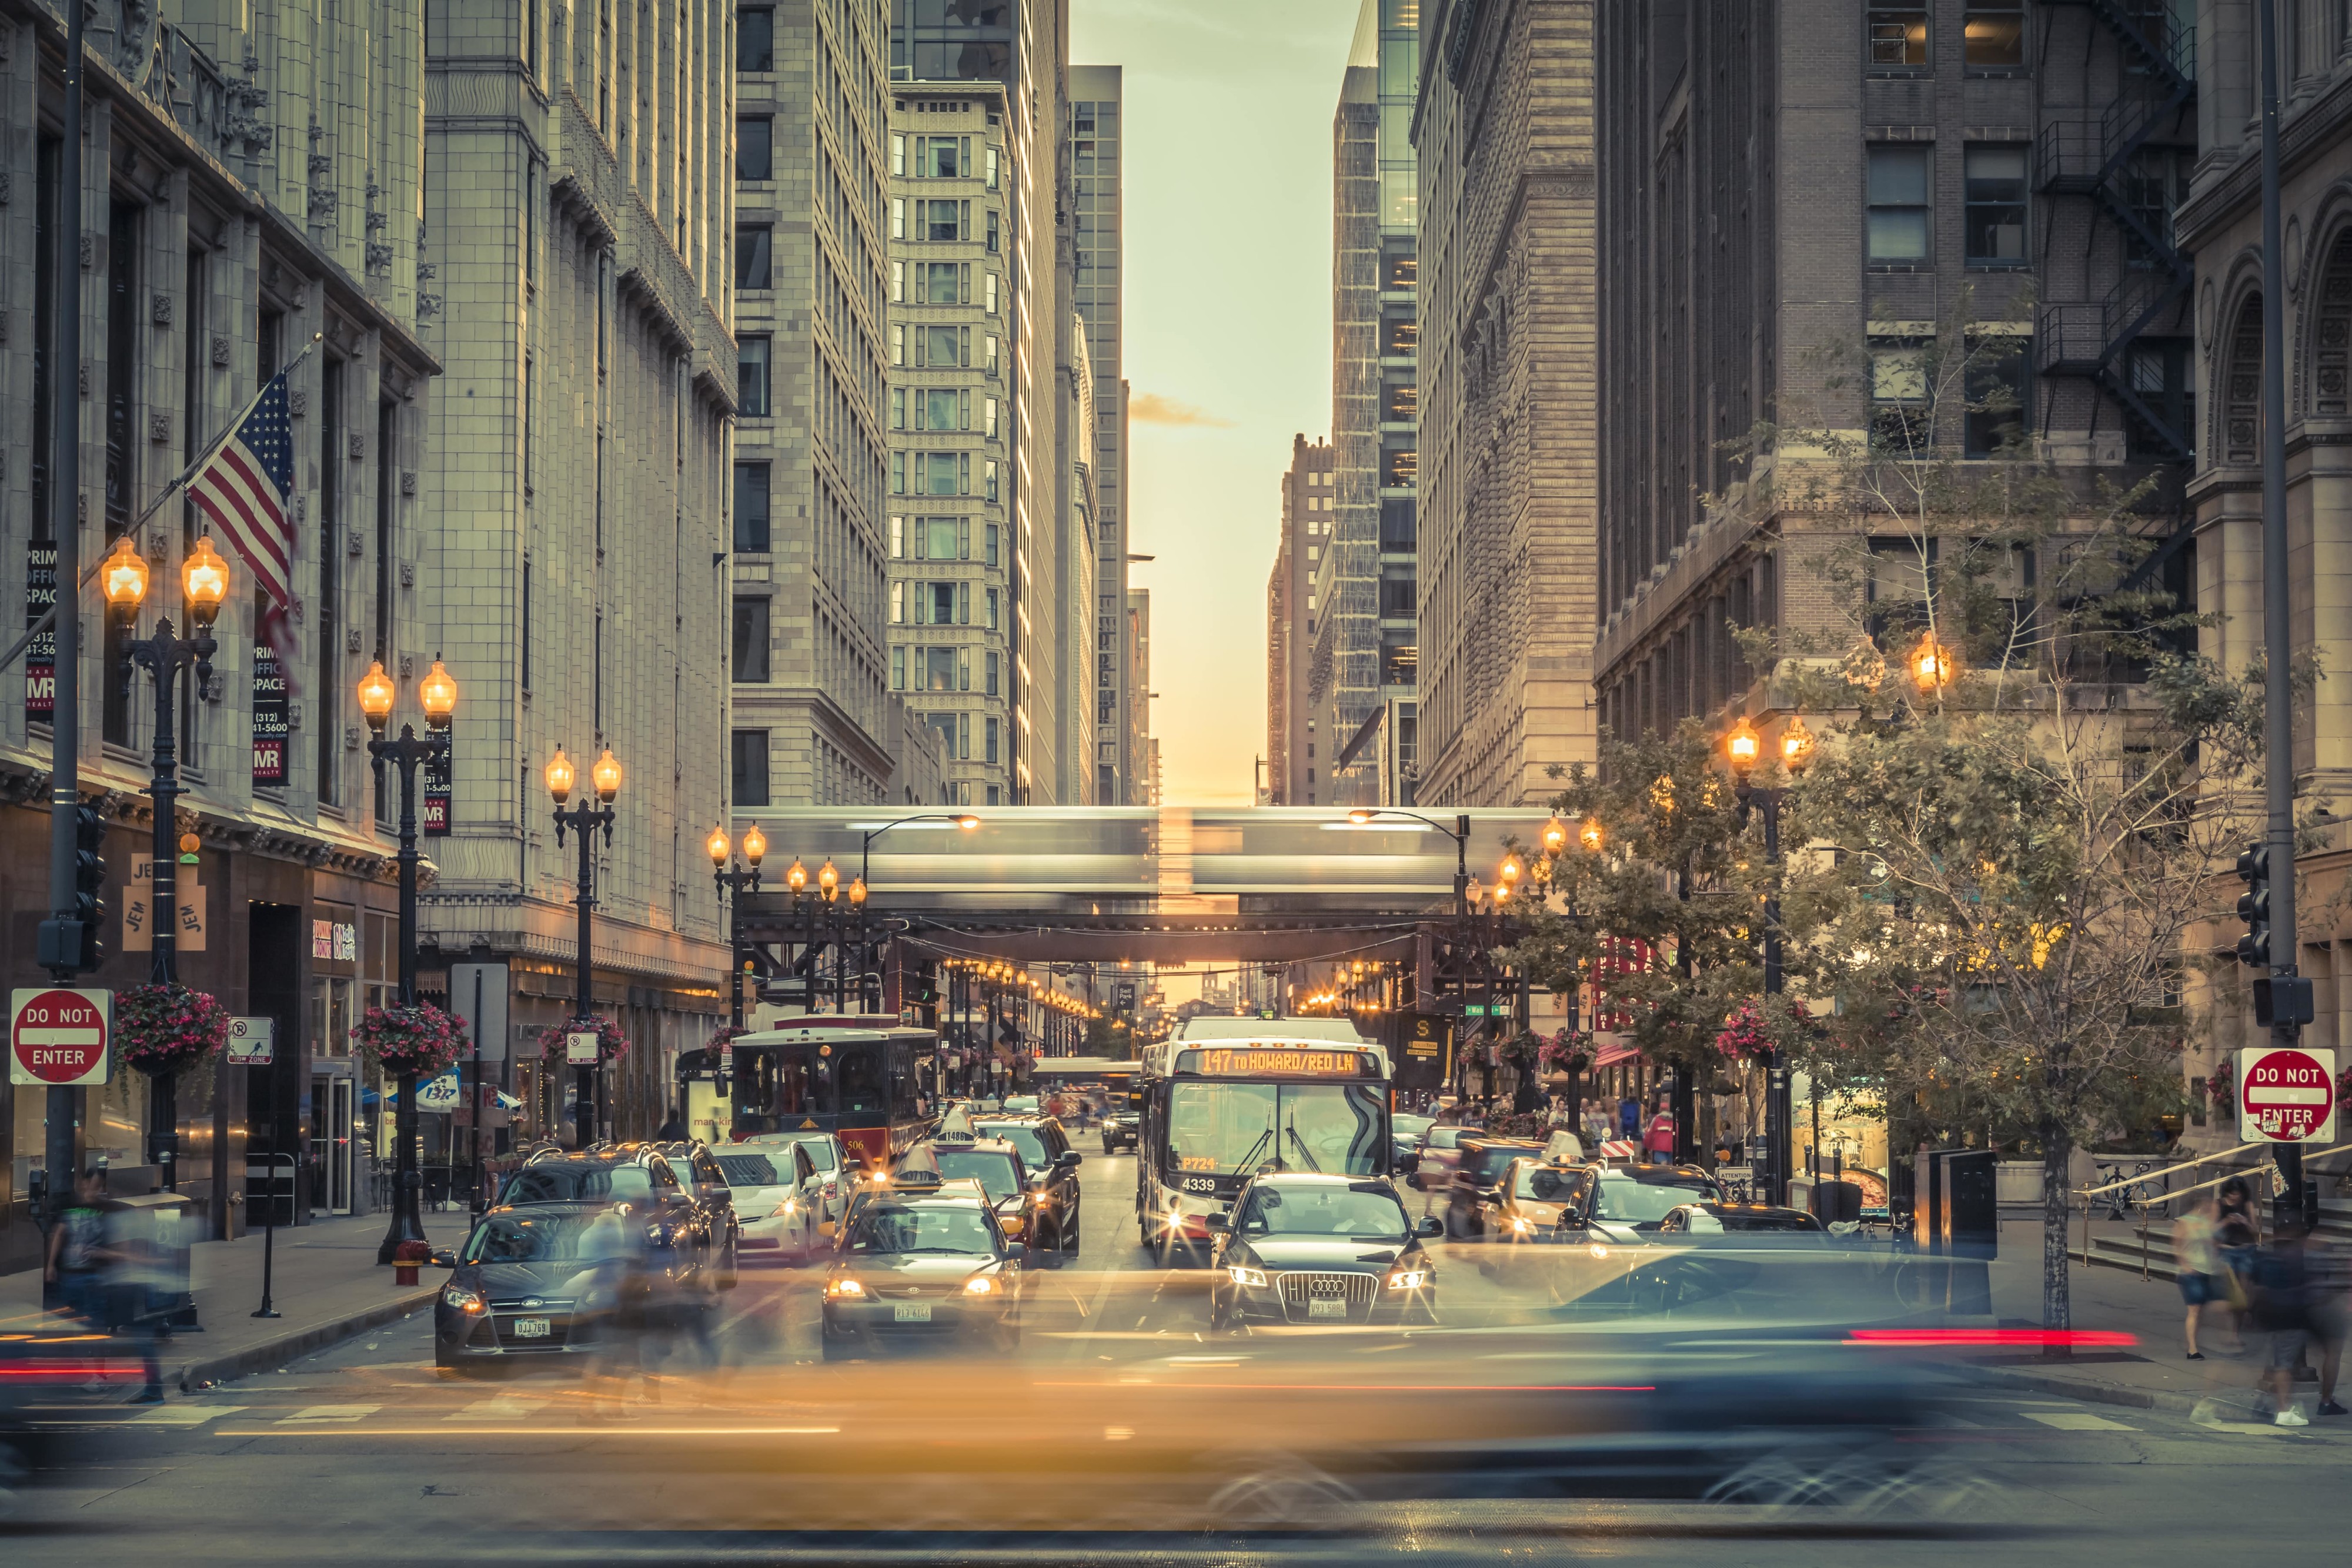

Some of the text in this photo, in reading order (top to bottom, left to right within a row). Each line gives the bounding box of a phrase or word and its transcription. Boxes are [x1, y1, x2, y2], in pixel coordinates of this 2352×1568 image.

[27, 678, 55, 698] MR
[256, 713, 278, 723] (312)
[254, 750, 279, 767] MR
[425, 807, 443, 821] MR
[126, 901, 146, 932] JEM
[180, 904, 201, 932] JEM
[1579, 994, 1588, 1009] JEM
[27, 1009, 92, 1023] DO NOT
[33, 1050, 84, 1064] ENTER
[1204, 1049, 1353, 1072] 147 TO HOWARD/RED LN
[2257, 1068, 2319, 1083] DO NOT
[2263, 1109, 2313, 1123] ENTER
[947, 1132, 965, 1141] 1486
[847, 1140, 864, 1150] 506
[1182, 1157, 1215, 1170] P724
[1182, 1178, 1215, 1191] 4339
[897, 1309, 909, 1318] R13
[519, 1323, 546, 1333] DJJ 769
